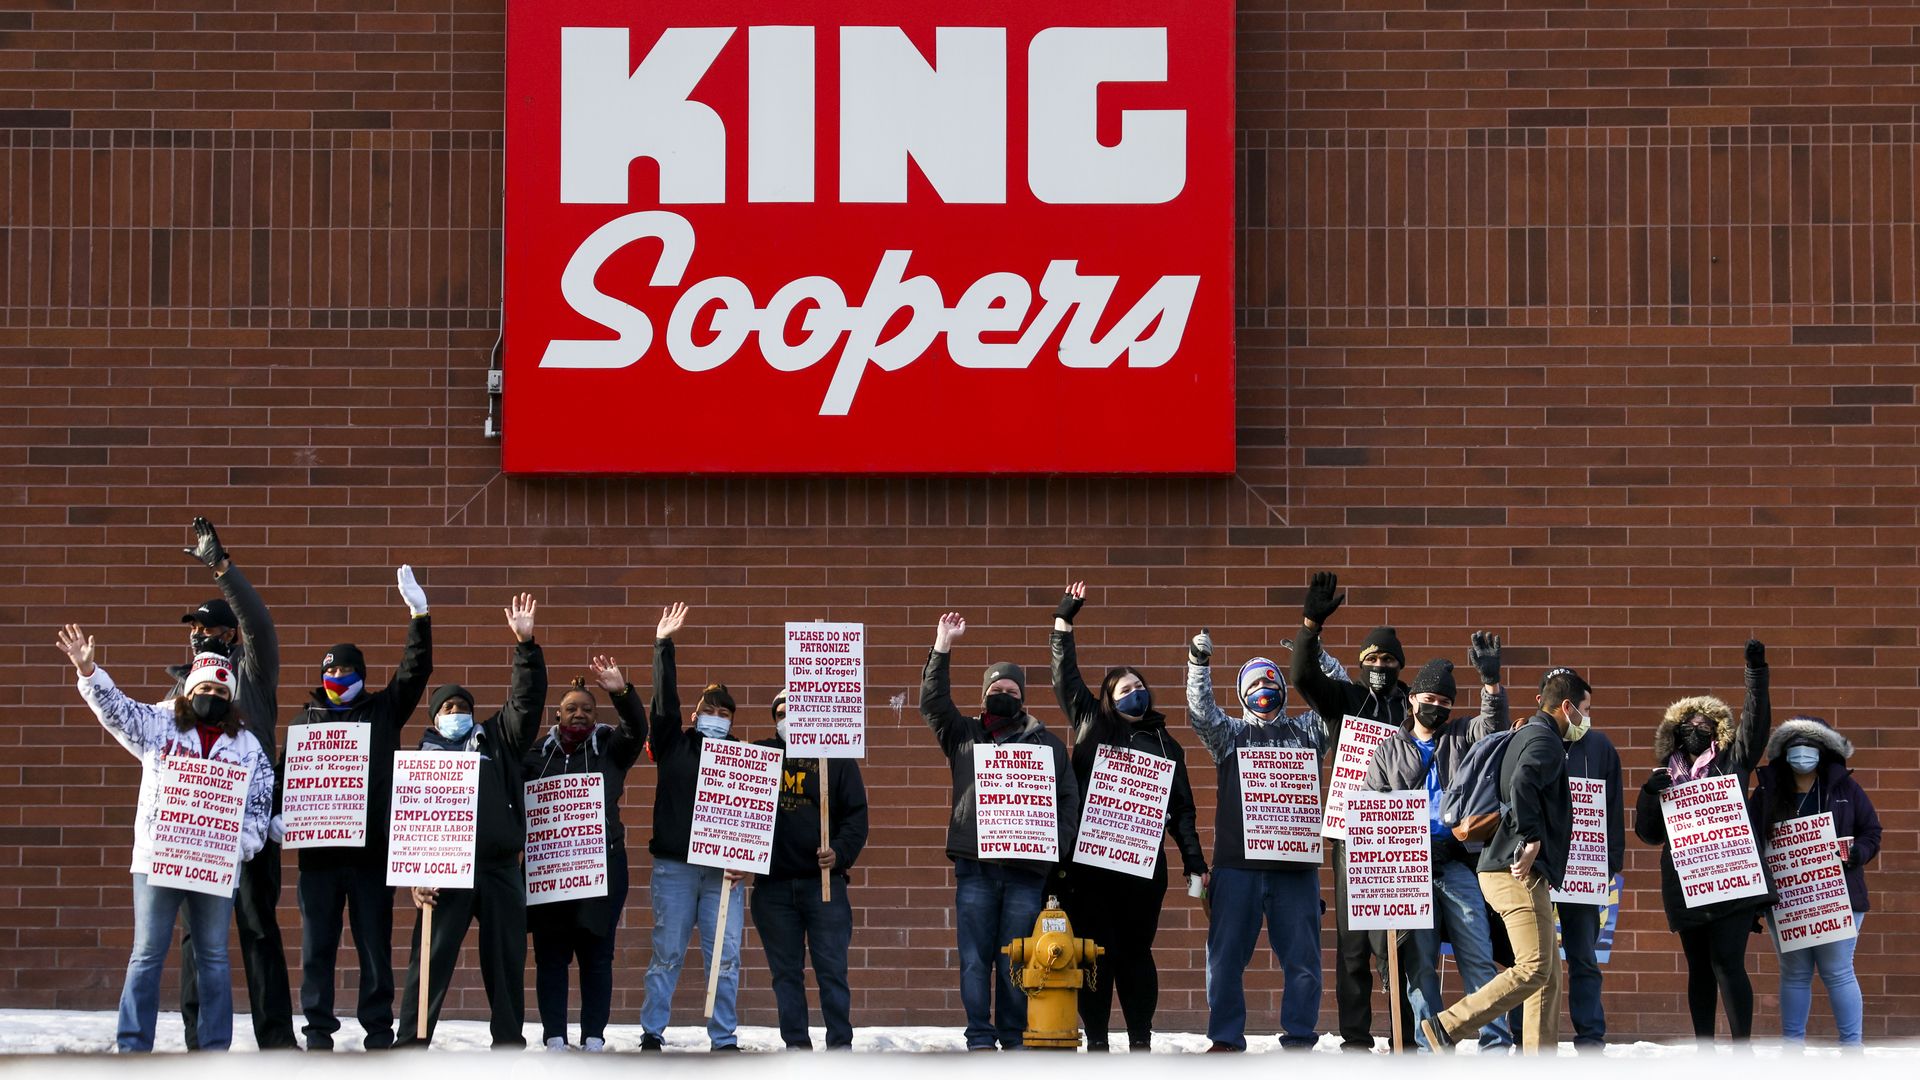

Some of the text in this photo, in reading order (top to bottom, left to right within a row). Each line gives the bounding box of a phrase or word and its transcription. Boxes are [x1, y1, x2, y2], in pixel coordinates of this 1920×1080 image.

[560, 25, 1187, 204] KING
[538, 210, 1201, 416] Soopers
[788, 630, 861, 642] PLEASE DO NOT
[799, 642, 850, 653] PATRONIZE
[788, 656, 861, 667] KING SOOPER'S
[792, 666, 858, 678] (Div. of Kroger)
[788, 680, 862, 693] EMPLOYEES
[788, 694, 863, 704] ON UNFAIR LABOR
[788, 703, 862, 714] PRACTICE STRIKE
[1343, 719, 1382, 736] PLEASE
[308, 729, 348, 741] DO NOT
[789, 732, 862, 745] UFCW LOCAL #7
[296, 739, 358, 752] PATRONIZE
[703, 741, 781, 763] PLEASE DO NOT
[1339, 743, 1365, 756] KING
[287, 754, 368, 764] KING SOOPER'S
[994, 749, 1033, 760] DO NOT
[1097, 747, 1173, 774] PLEASE DO NOT
[1239, 750, 1315, 761] PLEASE DO NOT
[1341, 753, 1362, 764] (Div.
[397, 759, 477, 770] PLEASE DO NOT
[714, 754, 768, 772] PATRONIZE
[984, 759, 1044, 771] PATRONIZE
[1252, 759, 1305, 770] PATRONIZE
[167, 760, 247, 782] PLEASE DO NOT
[408, 771, 464, 781] PATRONIZE
[700, 766, 778, 787] KING SOOPER'S
[1107, 759, 1160, 781] PATRONIZE
[1241, 771, 1317, 782] KING SOOPER'S
[177, 772, 234, 791] PATRONIZE
[286, 776, 363, 790] EMPLOYEES
[976, 772, 1056, 783] KING SOOPER'S
[1092, 770, 1168, 795] KING SOOPER'S
[395, 785, 475, 795] KING SOOPER'S
[526, 776, 601, 794] PLEASE DO NOT
[1333, 780, 1347, 789] ON
[1568, 781, 1604, 794] DO NOT
[163, 785, 243, 806] KING SOOPER'S
[536, 787, 589, 803] PATRONIZE
[697, 790, 775, 813] EMPLOYEES
[978, 793, 1053, 807] EMPLOYEES
[1243, 792, 1319, 805] EMPLOYEES
[1674, 790, 1729, 810] PATRONIZE
[525, 800, 602, 818] KING SOOPER'S
[1087, 793, 1164, 820] EMPLOYEES
[1244, 804, 1322, 816] ON UNFAIR LABOR
[1347, 798, 1427, 811] PLEASE DO NOT
[159, 809, 240, 833] EMPLOYEES
[394, 809, 474, 822] EMPLOYEES
[1359, 810, 1415, 822] PATRONIZE
[526, 823, 603, 843] EMPLOYEES
[1347, 825, 1428, 836] KING SOOPER'S
[1672, 824, 1750, 849] EMPLOYEES
[393, 833, 473, 842] PRACTICE STRIKE
[1352, 835, 1424, 847] (Div. of Kroger)
[1769, 829, 1822, 851] PATRONIZE
[691, 840, 769, 863] UFCW LOCAL #7
[1246, 838, 1321, 853] UFCW LOCAL #7
[1078, 840, 1154, 868] UFCW LOCAL #7
[1349, 849, 1429, 864] EMPLOYEES
[152, 861, 232, 886] UFCW LOCAL #7
[391, 861, 471, 874] UFCW LOCAL #7
[1348, 864, 1430, 875] ON UNFAIR LABOR
[528, 878, 557, 894] UFCW
[558, 874, 592, 890] LOCAL
[1348, 874, 1429, 885] PRACTICE STRIKE
[1684, 880, 1714, 897] UFCW
[1715, 874, 1751, 891] LOCAL
[1394, 886, 1420, 894] DISPUTE
[1562, 879, 1607, 894] LOCAL #7
[1399, 891, 1430, 899] EMPLOYER
[1351, 903, 1430, 917] UFCW LOCAL #7
[1779, 924, 1807, 942] UFCW
[1808, 917, 1841, 936] LOCAL
